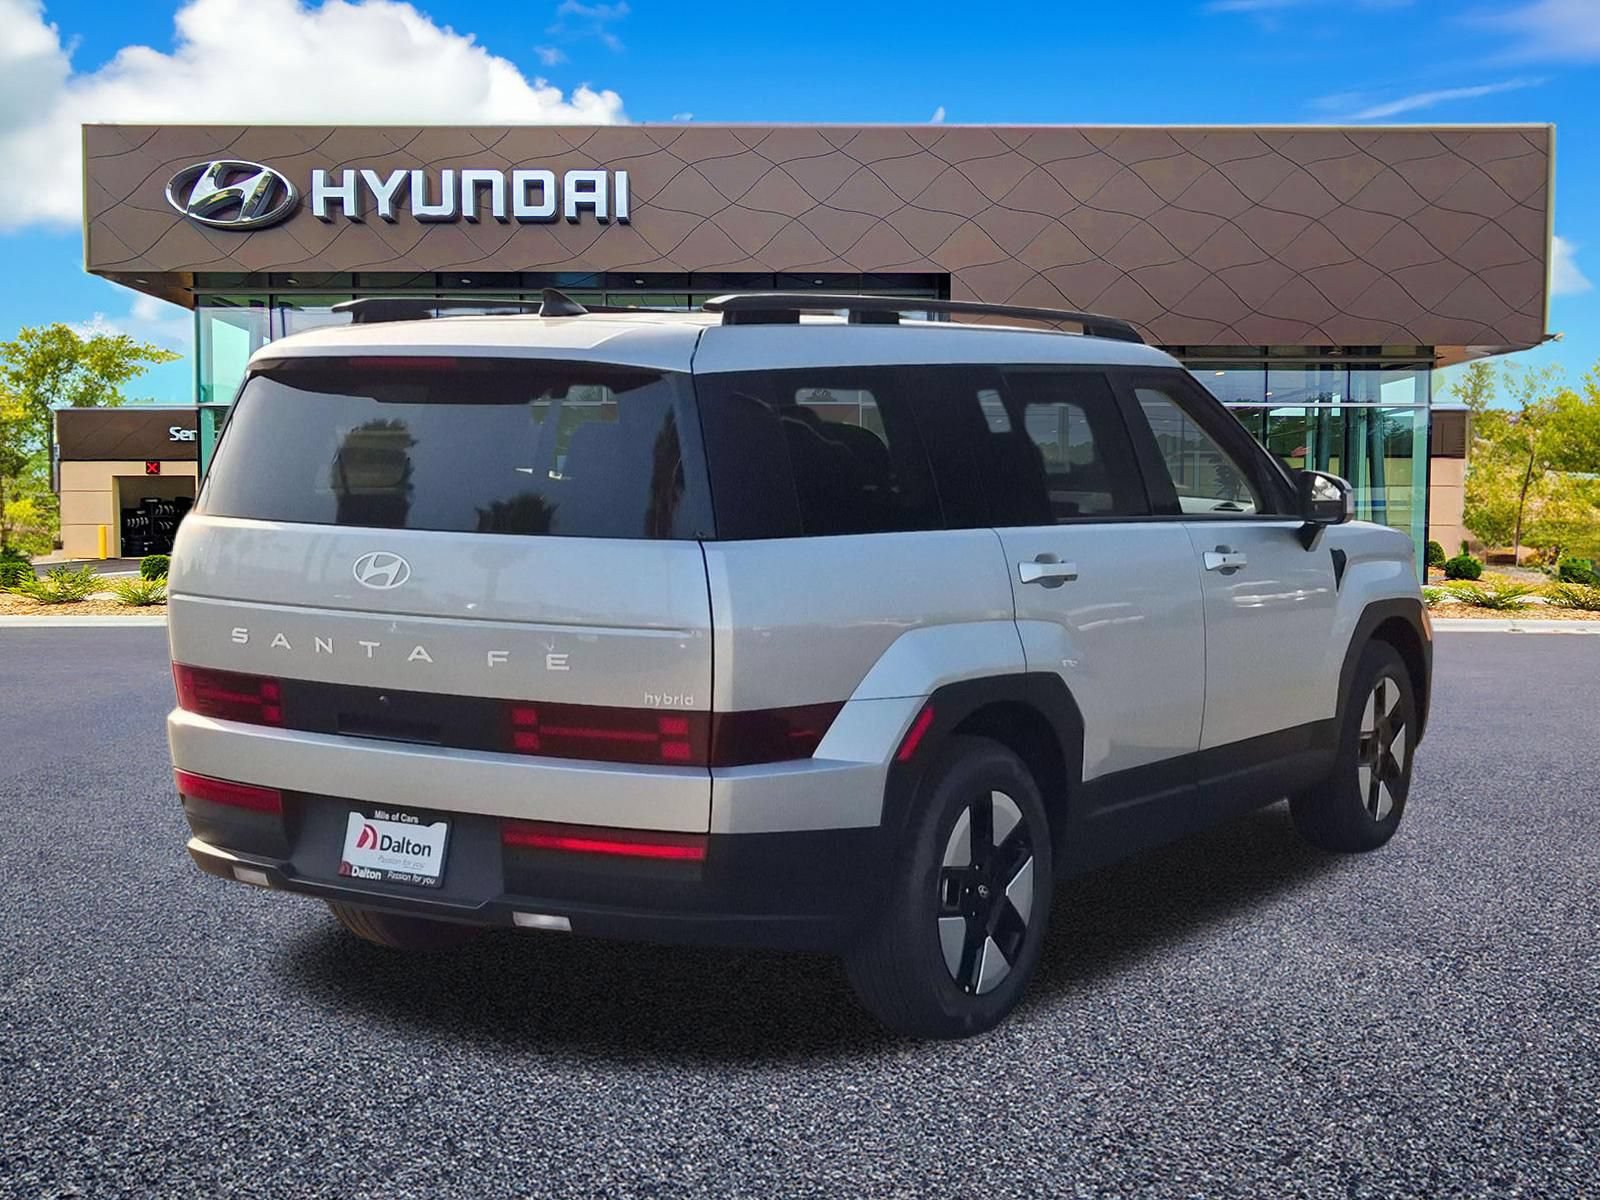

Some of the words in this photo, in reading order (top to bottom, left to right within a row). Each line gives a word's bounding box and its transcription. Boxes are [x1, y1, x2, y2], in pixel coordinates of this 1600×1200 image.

[312, 169, 629, 220] HYUNDAI
[231, 627, 434, 664] SANTA
[487, 650, 571, 672] FE
[644, 691, 694, 708] hybrid
[374, 810, 390, 820] Mile
[391, 812, 399, 821] of
[400, 814, 419, 824] Cars
[380, 834, 432, 857] Dalton
[352, 866, 382, 881] Dalton
[387, 871, 412, 883] Passion
[412, 874, 422, 884] for
[422, 877, 435, 886] you
